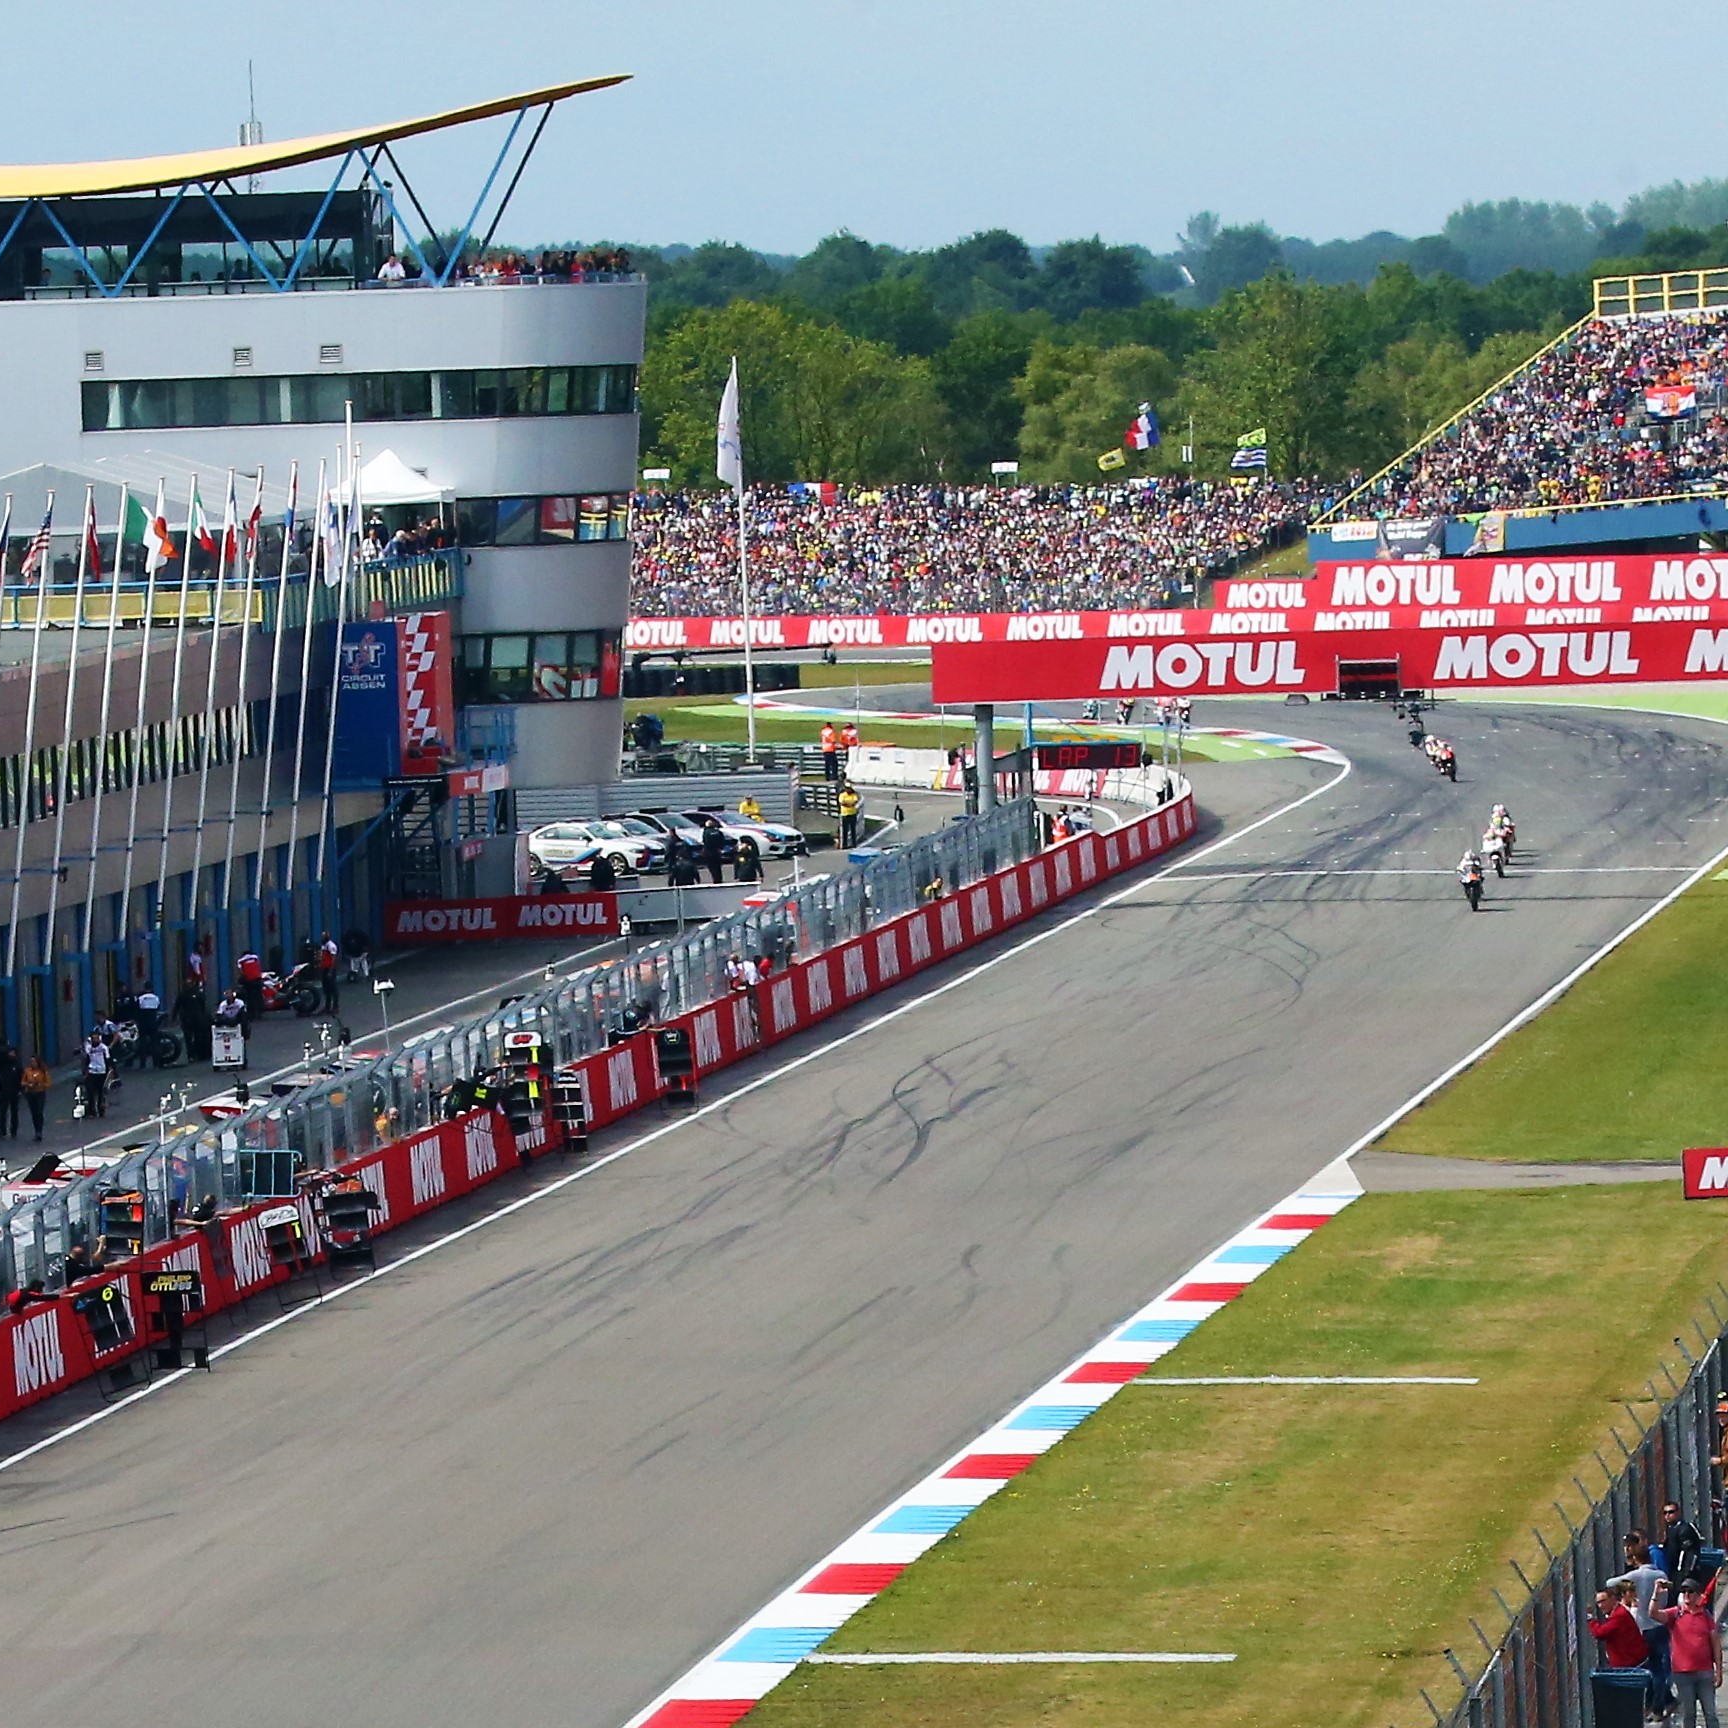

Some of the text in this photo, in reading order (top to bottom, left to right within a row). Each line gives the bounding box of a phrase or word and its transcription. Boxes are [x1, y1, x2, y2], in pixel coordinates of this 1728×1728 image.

[1227, 582, 1306, 609] MOTUL
[1332, 565, 1461, 606] MOTUL
[1489, 562, 1622, 604] MOTUL
[710, 620, 785, 645] MOTUL
[807, 619, 883, 644] MOTUL
[906, 617, 983, 642] MOTUL
[1006, 615, 1083, 640] MOTUL
[1107, 613, 1185, 637] MOTUL
[1210, 612, 1289, 634] MOTUL
[1099, 641, 1306, 690] MOTUL
[1434, 632, 1639, 680] MOTUL
[1043, 745, 1137, 768] LAP 13
[397, 903, 608, 933] MOTUL MOTUL
[12, 1309, 65, 1397] MOTUL
